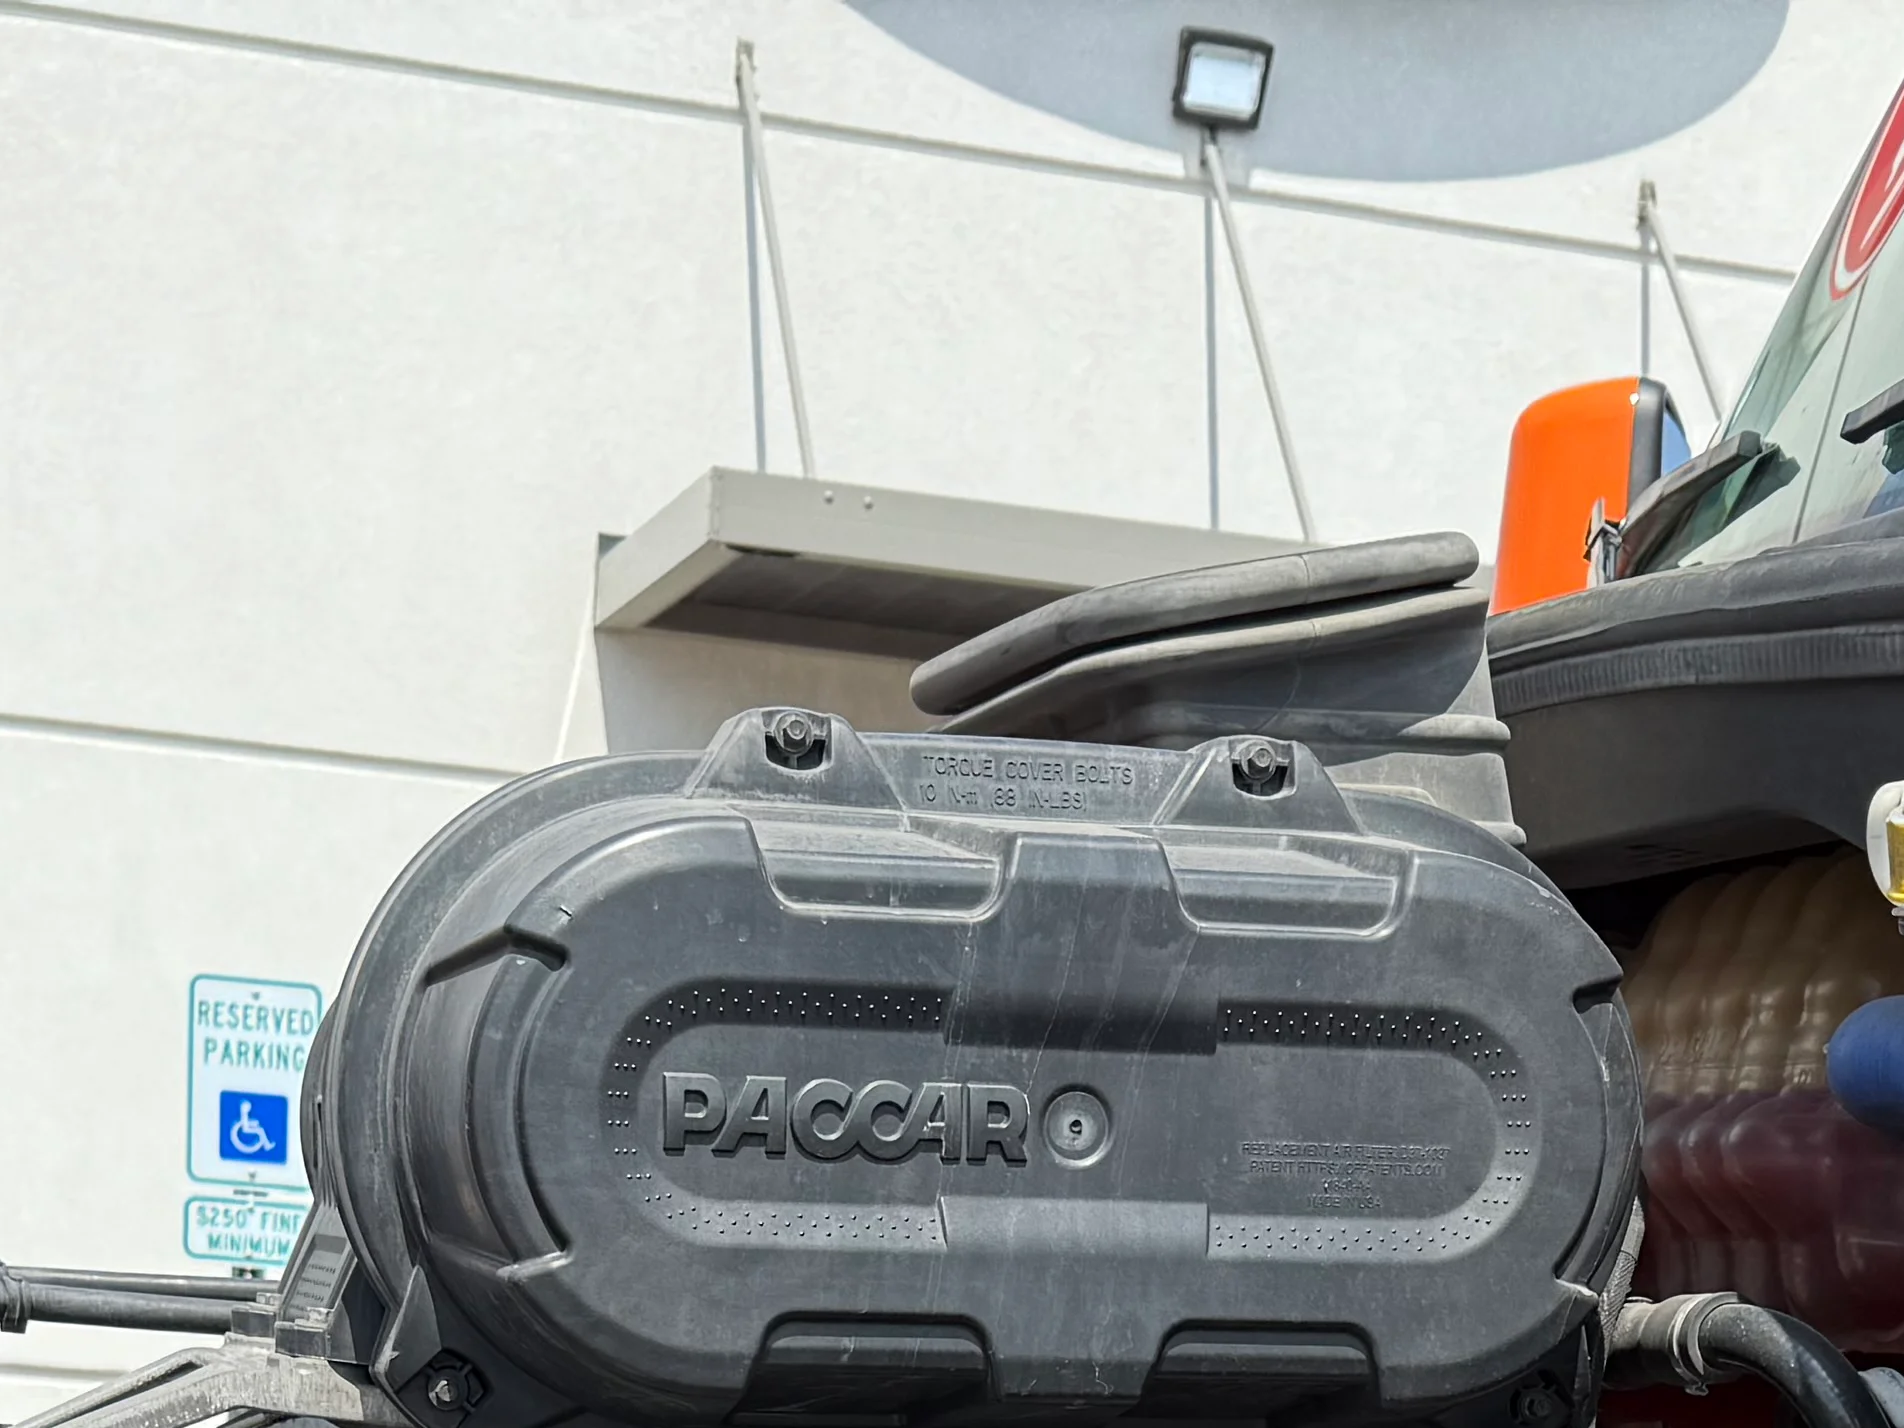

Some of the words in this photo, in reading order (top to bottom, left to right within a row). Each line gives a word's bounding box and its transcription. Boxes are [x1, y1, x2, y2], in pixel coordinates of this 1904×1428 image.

[923, 755, 993, 778] TORQUE
[1006, 761, 1063, 781] COVER
[1075, 764, 1134, 784] BOLTS
[198, 1001, 313, 1035] RESERVED
[204, 1038, 305, 1072] PARKING
[662, 1071, 1029, 1166] PACCAR
[1250, 1160, 1295, 1173] PATENT
[197, 1206, 248, 1227] $250
[208, 1232, 293, 1257] MINIMUM
